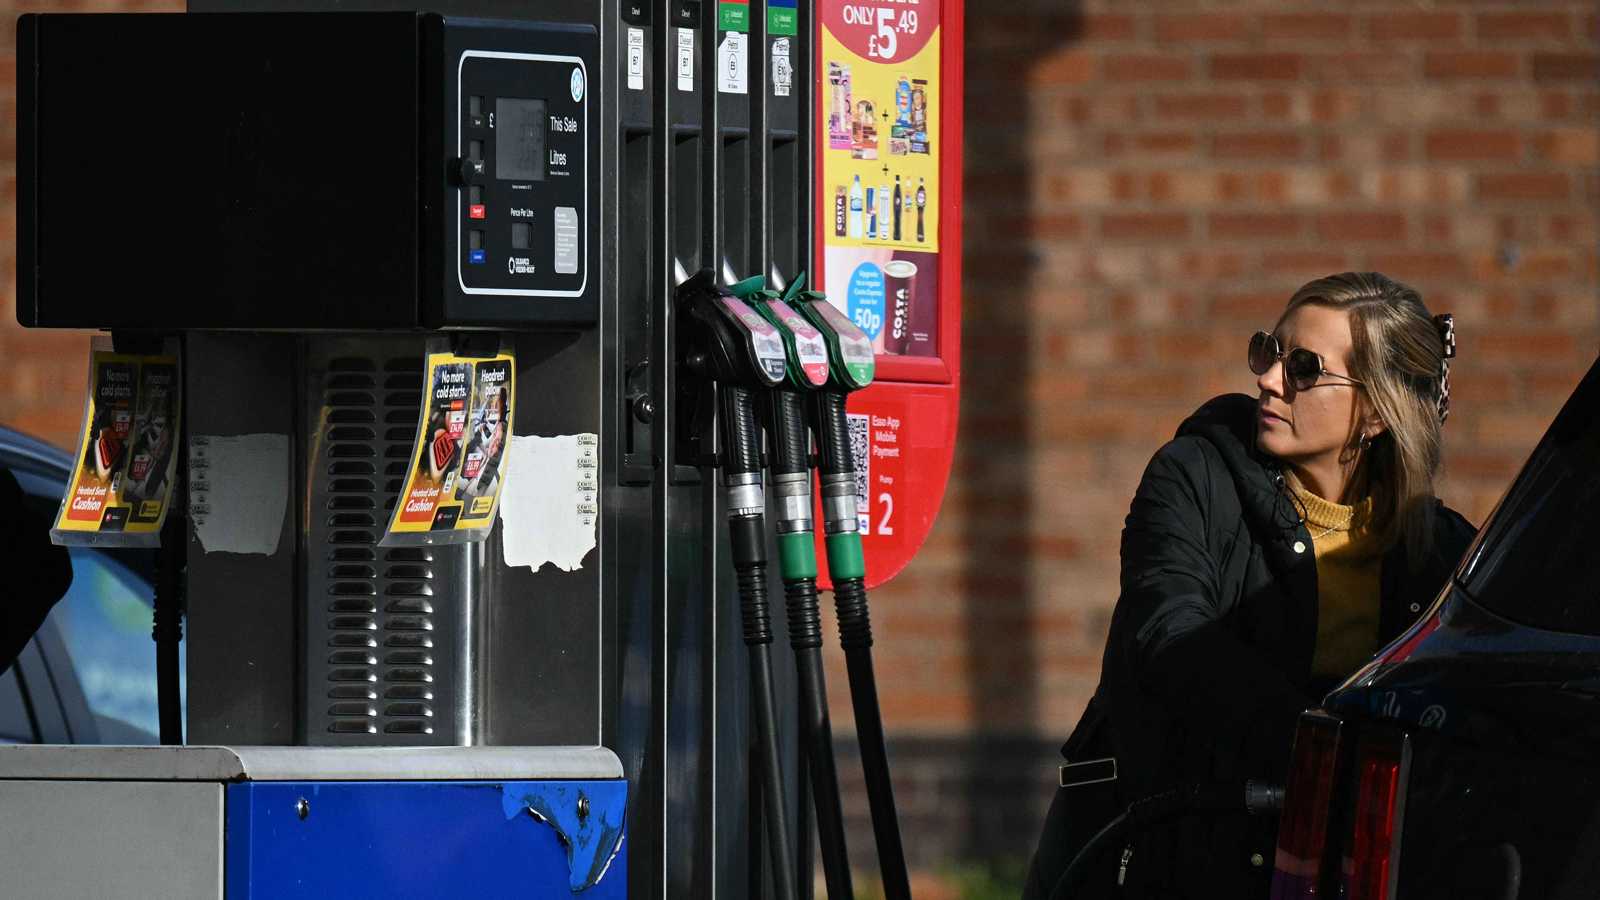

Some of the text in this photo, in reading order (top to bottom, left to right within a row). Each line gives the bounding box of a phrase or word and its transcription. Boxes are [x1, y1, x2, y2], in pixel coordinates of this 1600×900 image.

[843, 5, 875, 25] ONLY
[550, 116, 578, 133] This Sale
[550, 150, 567, 166] Litres
[855, 308, 880, 335] 50p
[892, 288, 905, 340] COSTA
[441, 369, 465, 384] No more
[481, 367, 505, 383] Headrest
[436, 385, 467, 399] cold starts.
[871, 415, 900, 430] Esso App
[875, 431, 897, 443] Mobile
[872, 445, 900, 459] Payment
[72, 497, 102, 512] Cushion
[405, 498, 434, 513] Cushion
[878, 492, 893, 535] 2
